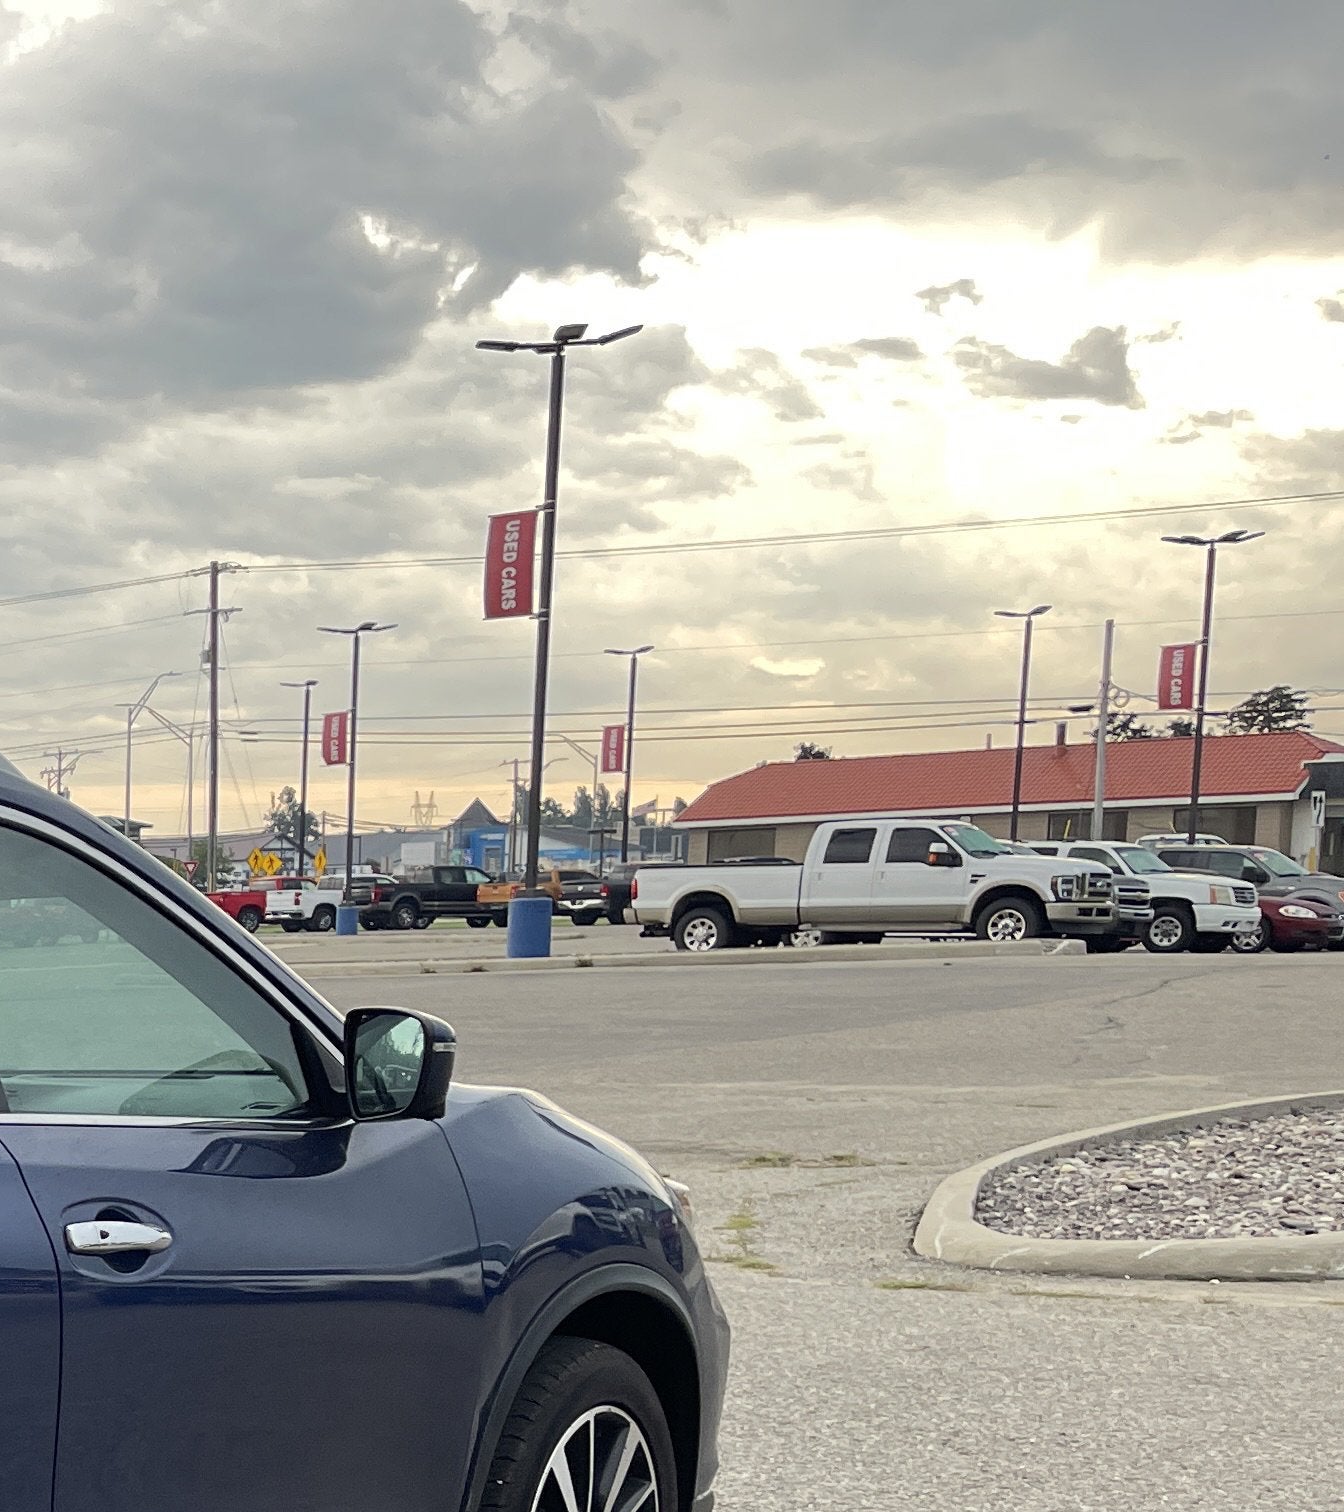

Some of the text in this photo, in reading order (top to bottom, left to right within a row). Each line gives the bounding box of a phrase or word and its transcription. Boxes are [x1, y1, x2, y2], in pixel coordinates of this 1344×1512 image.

[500, 519, 521, 610] USED CARS
[1170, 649, 1185, 705] USED CARS
